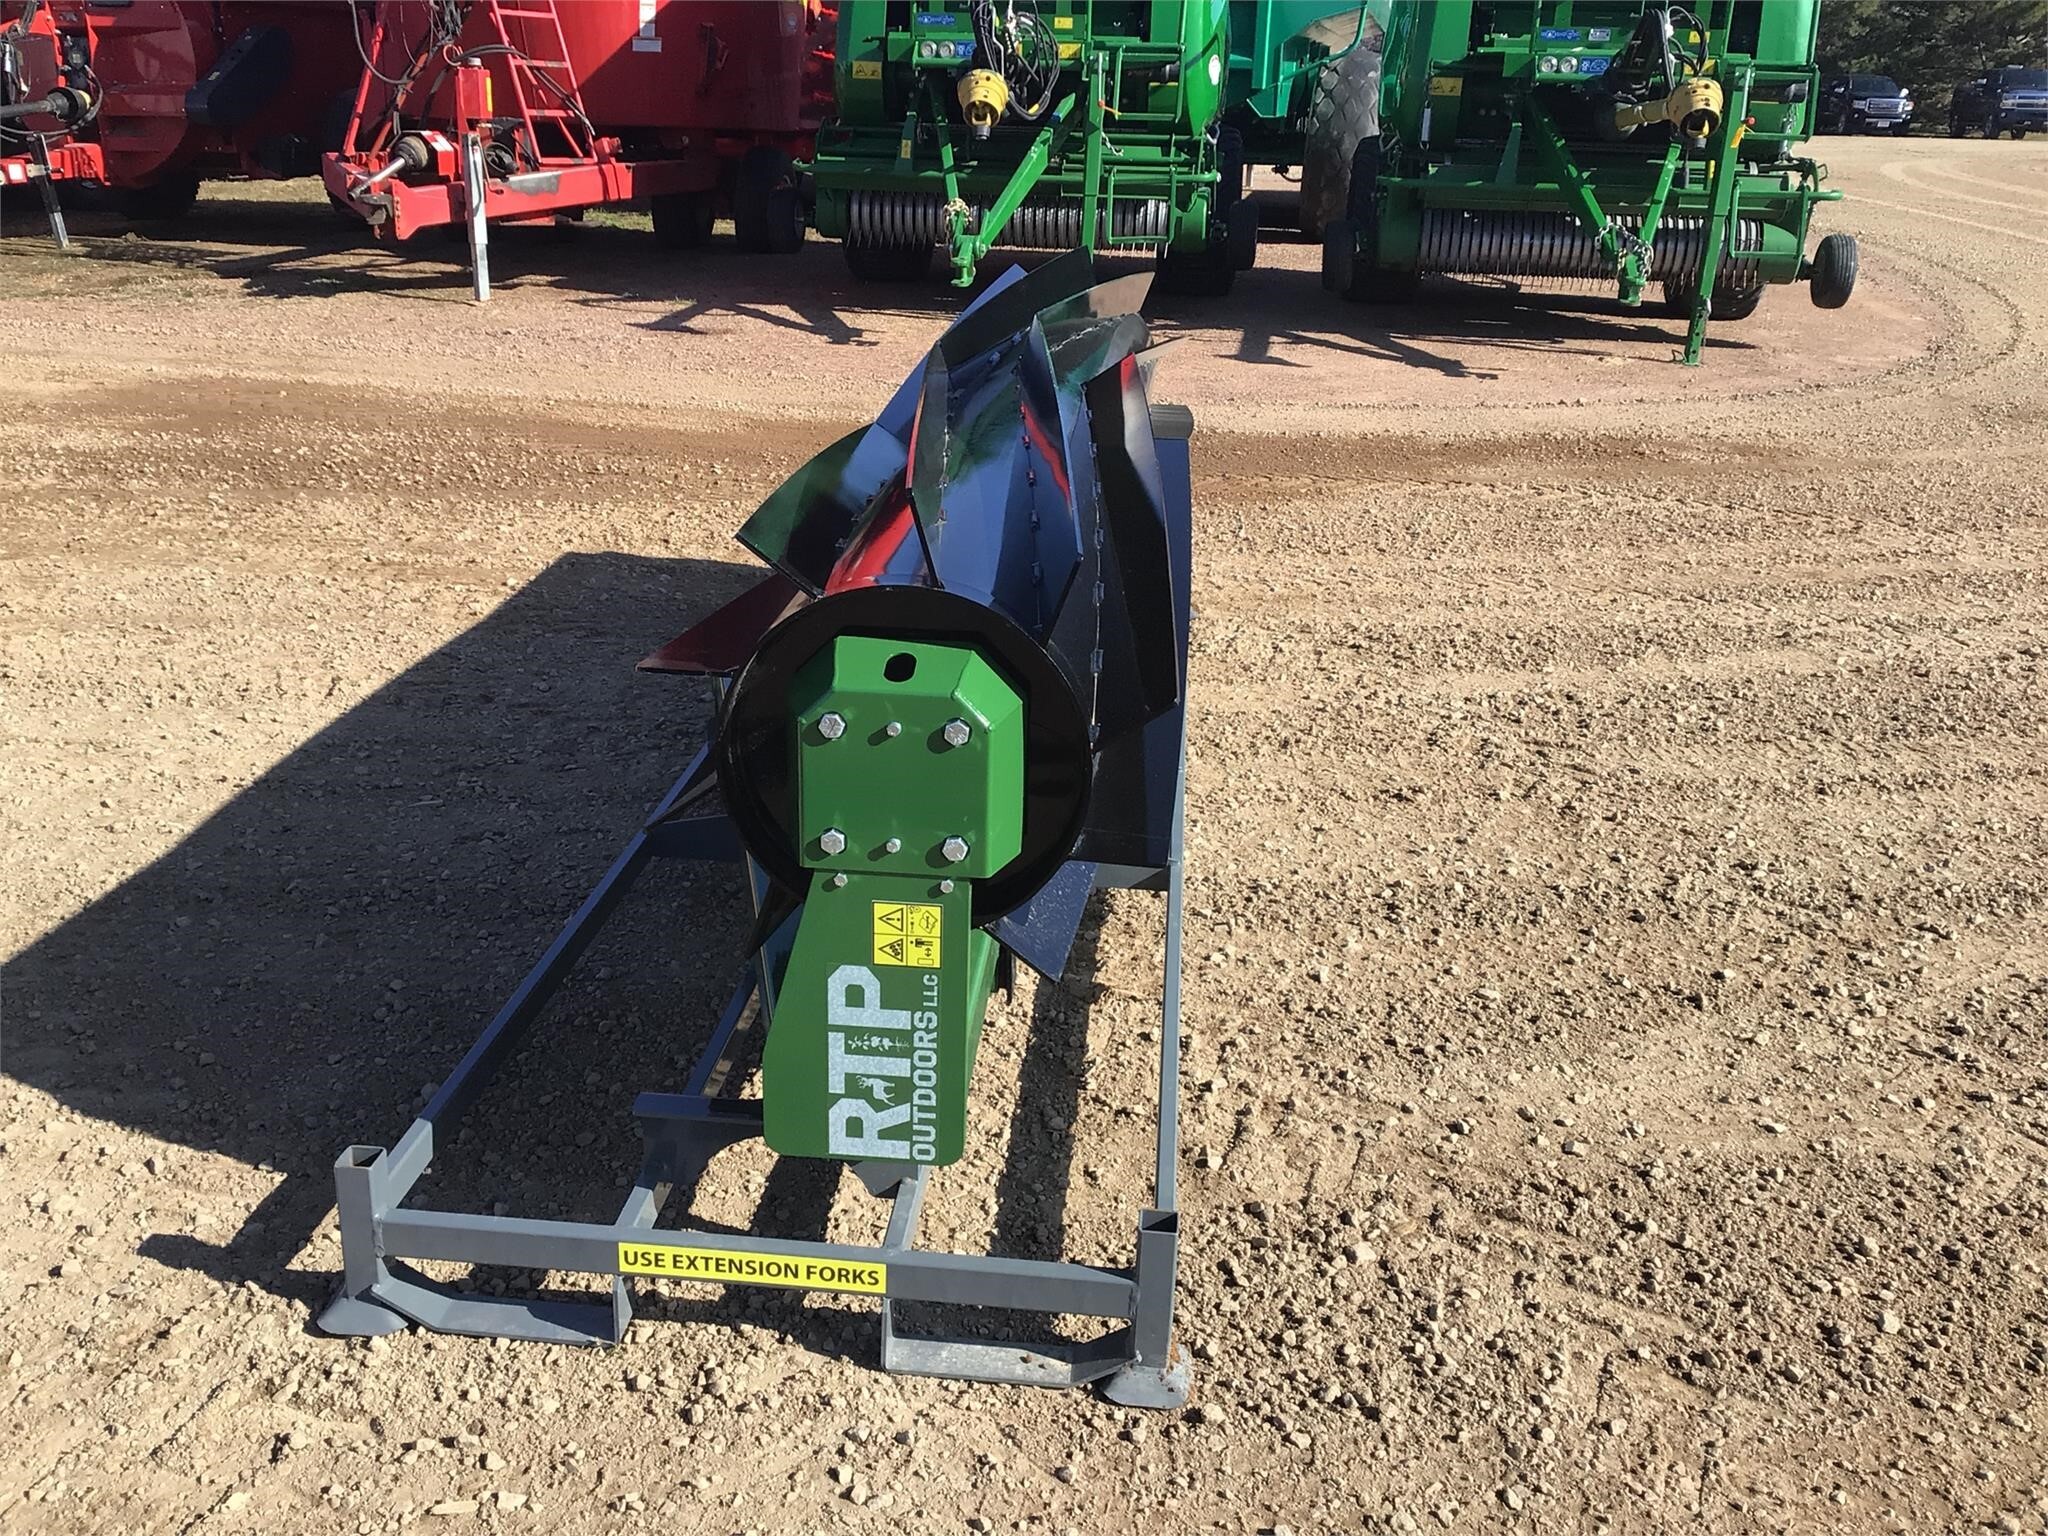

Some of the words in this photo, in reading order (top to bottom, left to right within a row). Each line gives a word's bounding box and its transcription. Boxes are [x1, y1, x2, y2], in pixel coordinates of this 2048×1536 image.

[923, 974, 938, 1006] LLC
[828, 965, 911, 1160] RTP
[912, 1011, 937, 1161] OUTDOORS
[623, 1250, 666, 1268] USE
[672, 1254, 799, 1279] EXTENSION
[805, 1265, 880, 1286] FORKS
